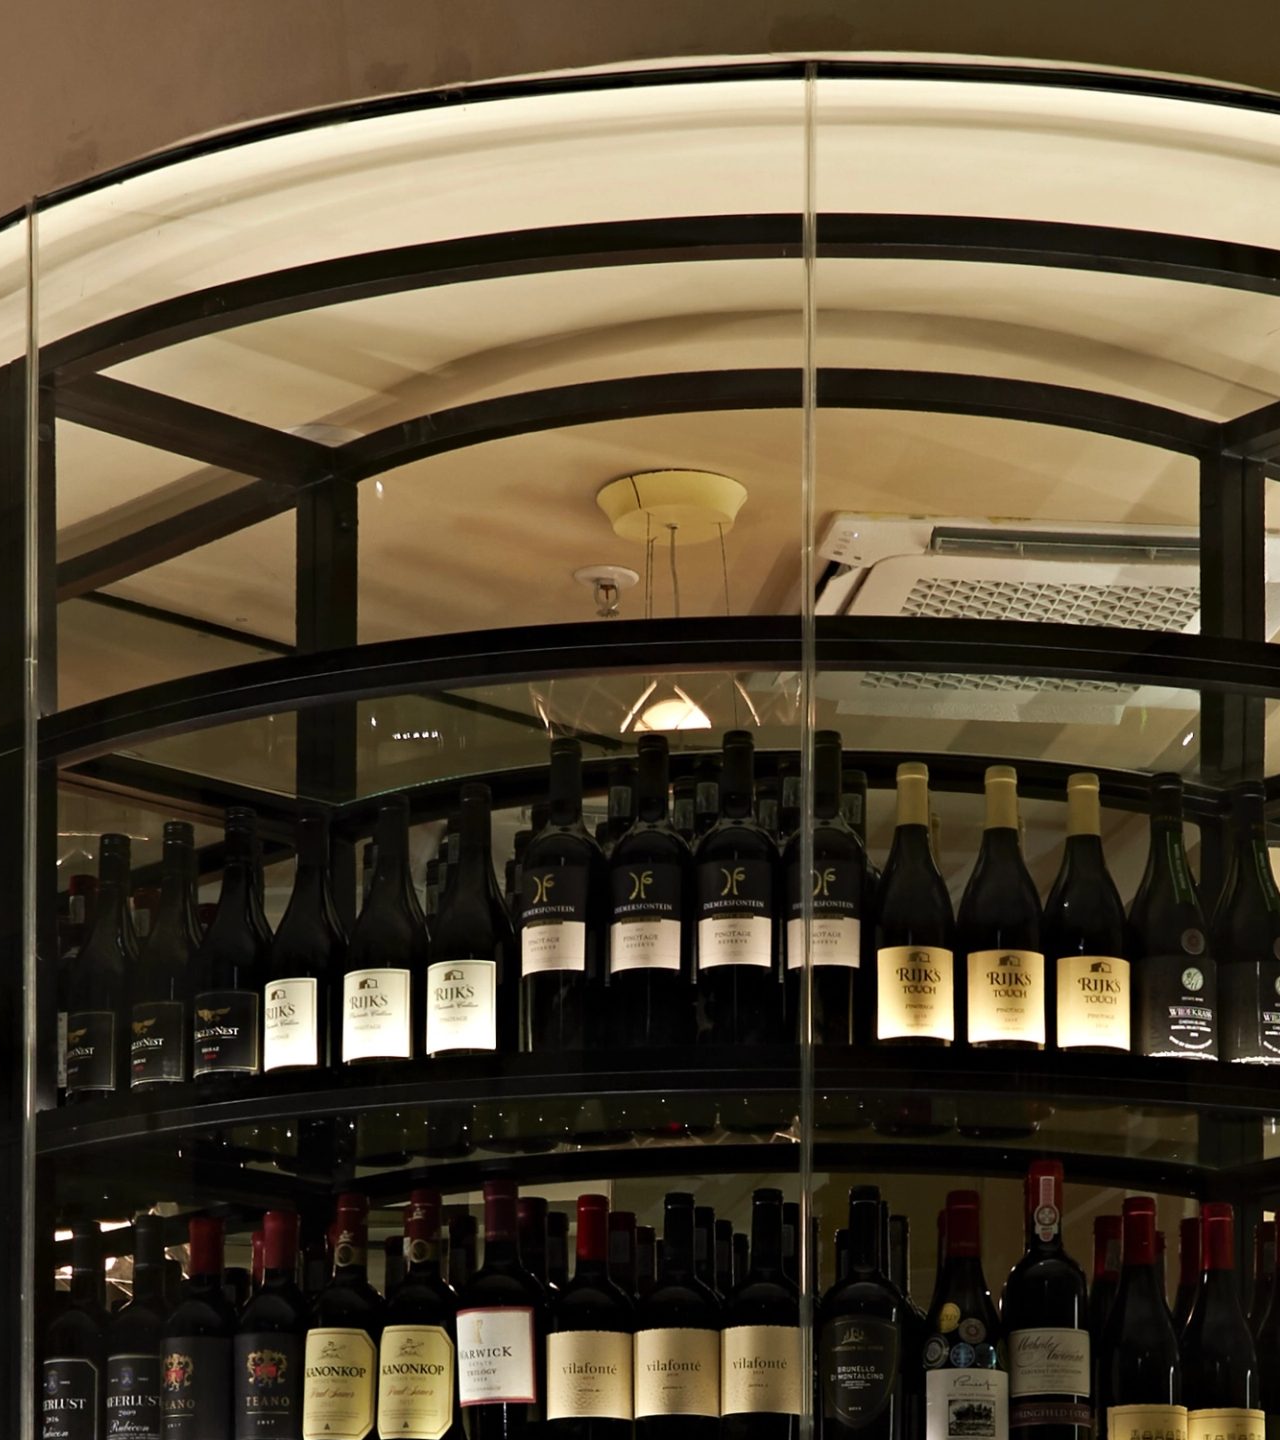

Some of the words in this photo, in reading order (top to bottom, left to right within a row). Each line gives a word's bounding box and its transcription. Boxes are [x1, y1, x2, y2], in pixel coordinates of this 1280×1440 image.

[903, 984, 936, 995] TOUCH
[993, 988, 1027, 999] TOUCH
[1084, 995, 1117, 1005] TOUCH
[382, 1363, 444, 1375] KANONKOP
[562, 1362, 618, 1375] vilafonté
[646, 1359, 701, 1372] vilafonté
[733, 1357, 787, 1370] vilafonté
[306, 1366, 366, 1378] KANONKOP
[837, 1366, 875, 1374] BRUNELLO
[246, 1397, 290, 1407] TEANO
[110, 1420, 150, 1433] Rubicon
